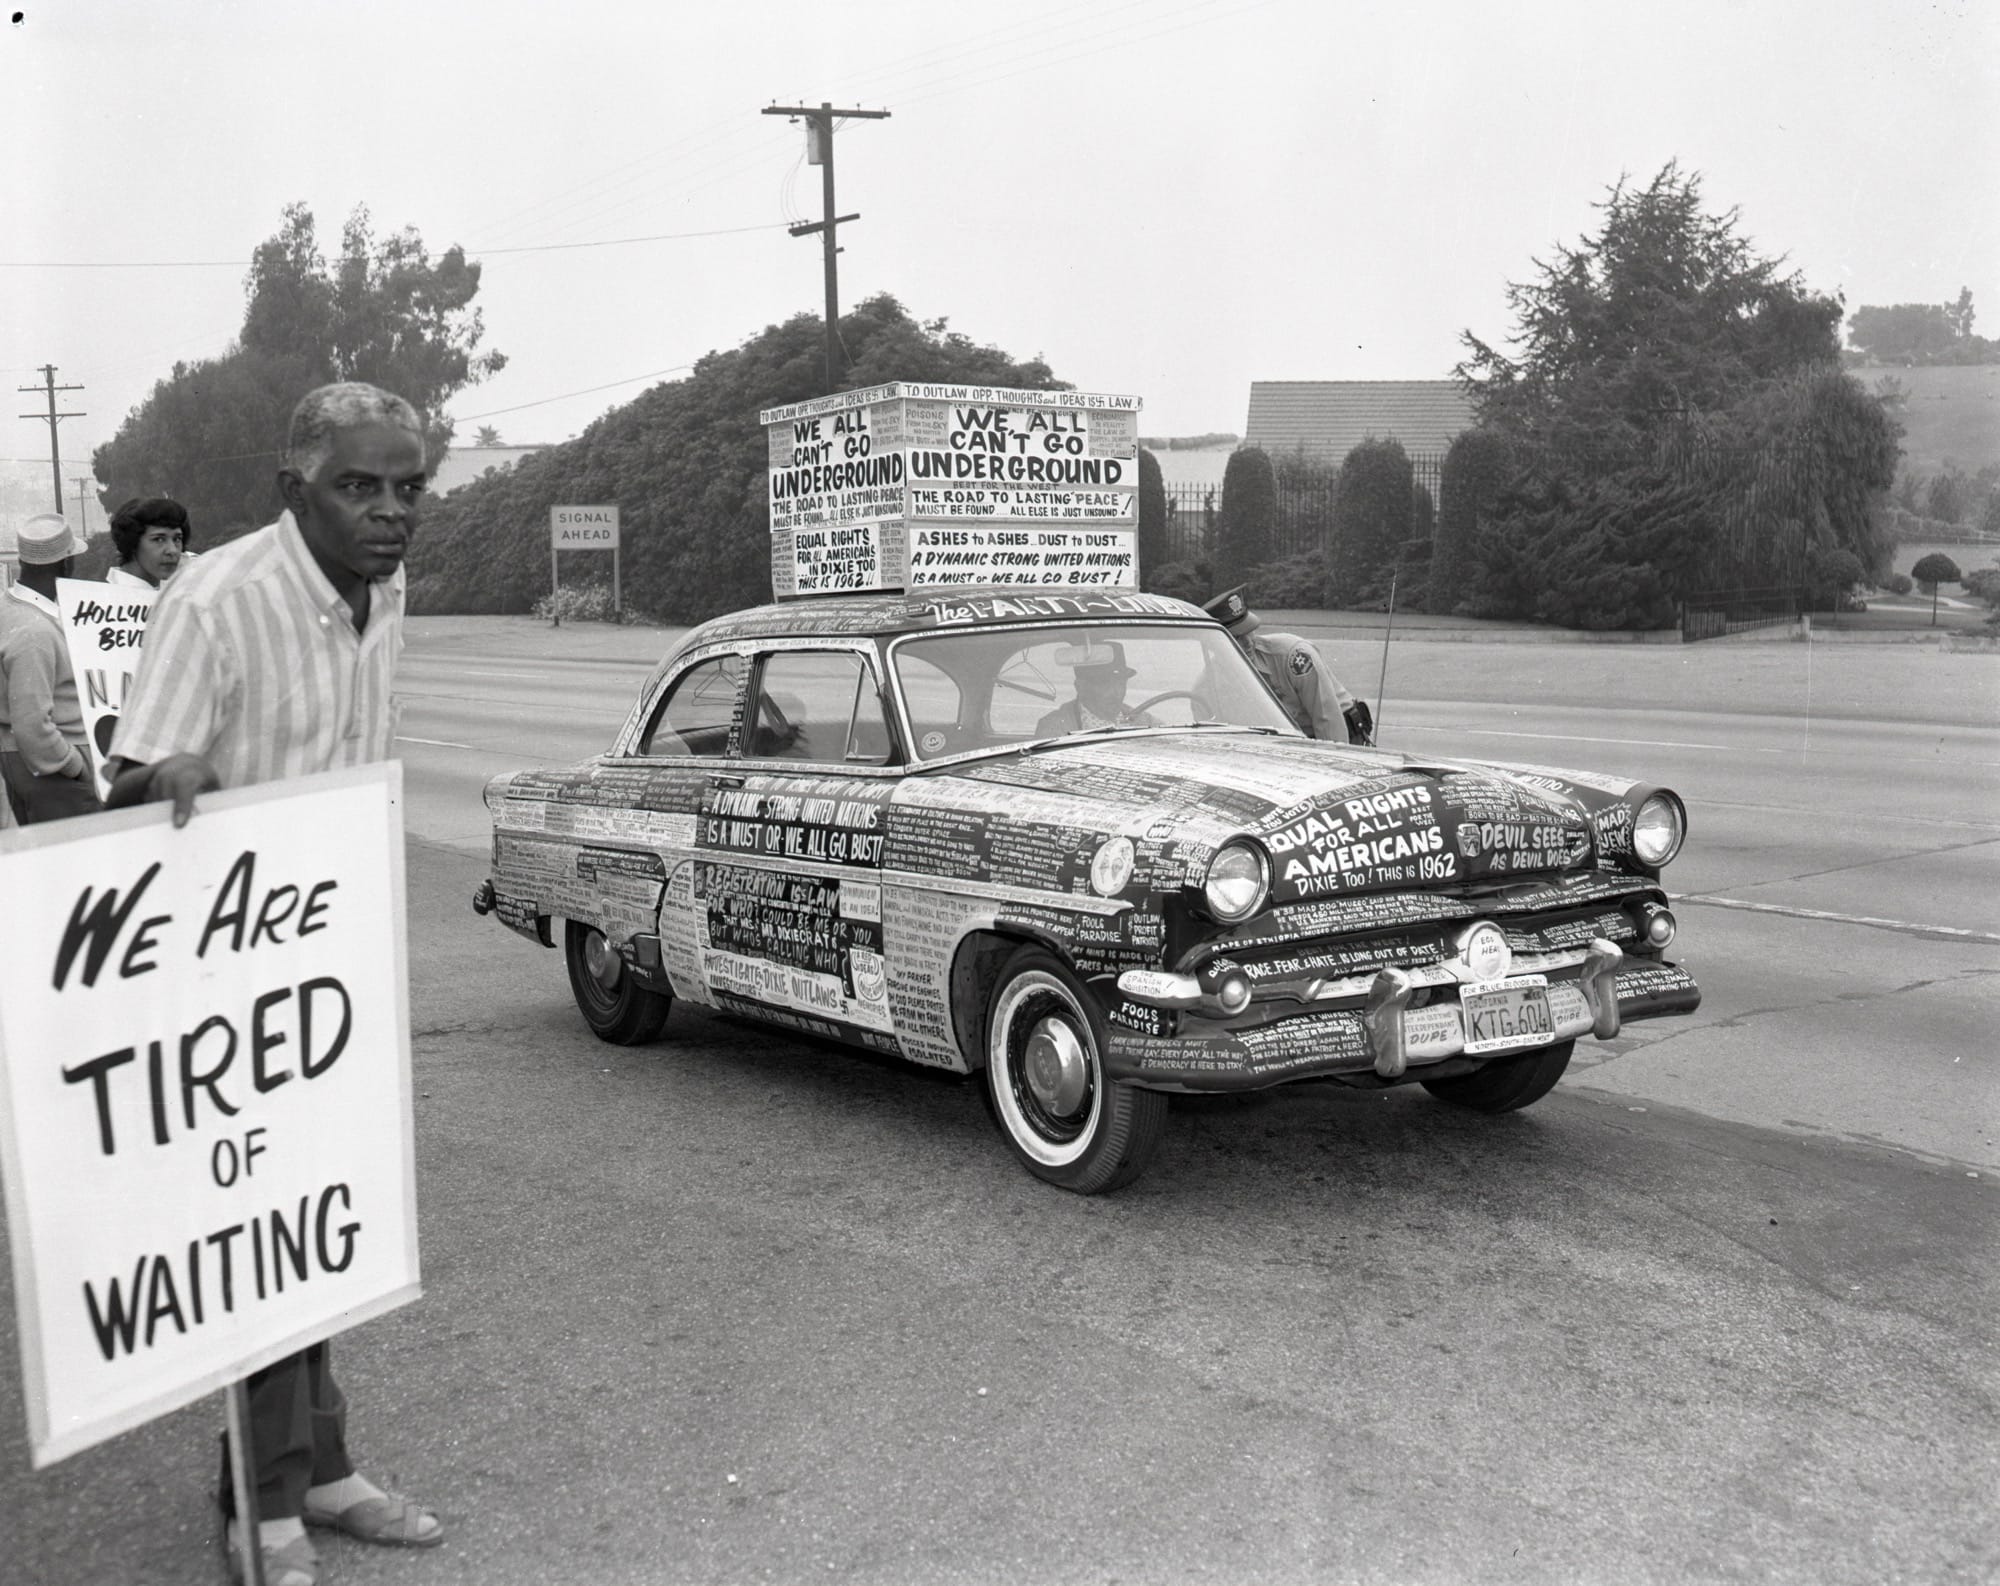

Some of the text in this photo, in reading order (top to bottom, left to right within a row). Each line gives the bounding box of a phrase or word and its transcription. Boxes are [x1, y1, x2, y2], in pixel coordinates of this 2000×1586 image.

[905, 384, 919, 397] TO
[924, 386, 968, 400] OUTLAW
[996, 390, 1043, 405] THOUGHTS
[1059, 394, 1086, 407] IDEAS
[1109, 396, 1132, 408] LAW
[794, 410, 867, 443] WE ALL
[955, 408, 1009, 431] WE
[1029, 412, 1086, 433] ALL
[794, 434, 871, 467] CAN'T GO
[950, 429, 1031, 454] CAN'T
[1042, 433, 1084, 455] GO
[773, 453, 903, 499] UNDERGROUND
[911, 450, 1122, 485] UNDERGROUND
[912, 490, 938, 503] THE
[943, 490, 985, 504] ROAD
[990, 491, 1009, 504] TO
[1015, 491, 1071, 505] LASTING
[981, 481, 997, 490] FOR
[1004, 482, 1023, 491] THE
[773, 486, 904, 515] THE ROAD TO LASTING PEACE
[915, 504, 946, 515] MUST
[950, 504, 963, 515] BE
[1010, 506, 1027, 517] ALL
[1028, 506, 1048, 517] ELSE
[1050, 507, 1059, 517] IS
[1062, 507, 1082, 518] JUST
[1084, 508, 1117, 518] UNSOUND
[559, 513, 612, 523] SIGNAL
[561, 529, 611, 540] AHEAD
[796, 527, 870, 550] EQUAL RIGHTS
[917, 531, 969, 546] ASHES
[972, 532, 984, 546] to
[1072, 533, 1083, 546] to
[797, 550, 812, 565] FOR
[825, 544, 876, 561] AMERICANS
[820, 559, 854, 576] DIXIE
[855, 557, 876, 573] TOO
[911, 551, 1132, 567] A DYNAMIC STRONG UNITED NATIONS
[798, 576, 817, 590] THIS
[821, 576, 830, 589] IS
[913, 572, 926, 584] IS
[927, 573, 938, 584] A
[938, 572, 975, 584] MUST
[976, 575, 988, 585] or
[991, 572, 1012, 584] WE
[1014, 573, 1038, 585] ALL
[1041, 572, 1062, 584] GO
[710, 790, 719, 815] A
[720, 790, 764, 817] DYNAMIC
[765, 795, 802, 821] STRONG
[801, 797, 836, 825] UNITED
[835, 800, 881, 829] NATIONS
[1344, 785, 1432, 822] RIGHTS
[1598, 809, 1625, 831] MAD
[707, 819, 718, 844] IS
[719, 819, 727, 845] A
[730, 821, 763, 849] MUST
[765, 825, 780, 852] OR
[785, 825, 804, 854] WE
[807, 829, 826, 857] ALL
[1311, 813, 1404, 855] FOR ALL
[1481, 822, 1528, 851] DEVIL
[1599, 826, 1626, 849] JEW
[1283, 826, 1445, 881] AMERICANS
[1490, 848, 1571, 871] AS DEVIL DOES
[706, 864, 787, 900] REGISTRATION
[809, 884, 841, 911] LAW
[1294, 873, 1340, 897] DIXIE
[1375, 864, 1403, 883] THIS
[1404, 864, 1416, 879] IS
[1419, 852, 1457, 881] 1962
[52, 850, 339, 991] WE ARE
[706, 891, 726, 913] FOR
[762, 907, 793, 927] COULD
[797, 911, 809, 930] BE
[814, 916, 829, 933] ME
[832, 920, 848, 940] OR
[852, 925, 873, 946] YOU
[710, 919, 728, 940] BUT
[767, 937, 810, 964] CALLING
[1080, 930, 1122, 943] PARADISE
[1349, 949, 1373, 963] LONG
[1374, 947, 1393, 960] OUT
[1396, 946, 1409, 957] OF
[791, 975, 838, 1009] OUTLAWS
[1108, 1009, 1160, 1036] PARADISE
[1120, 1001, 1158, 1022] FOOLS
[61, 976, 353, 1156] TIRED
[211, 1126, 268, 1189] OF
[83, 1182, 362, 1362] WAITING
